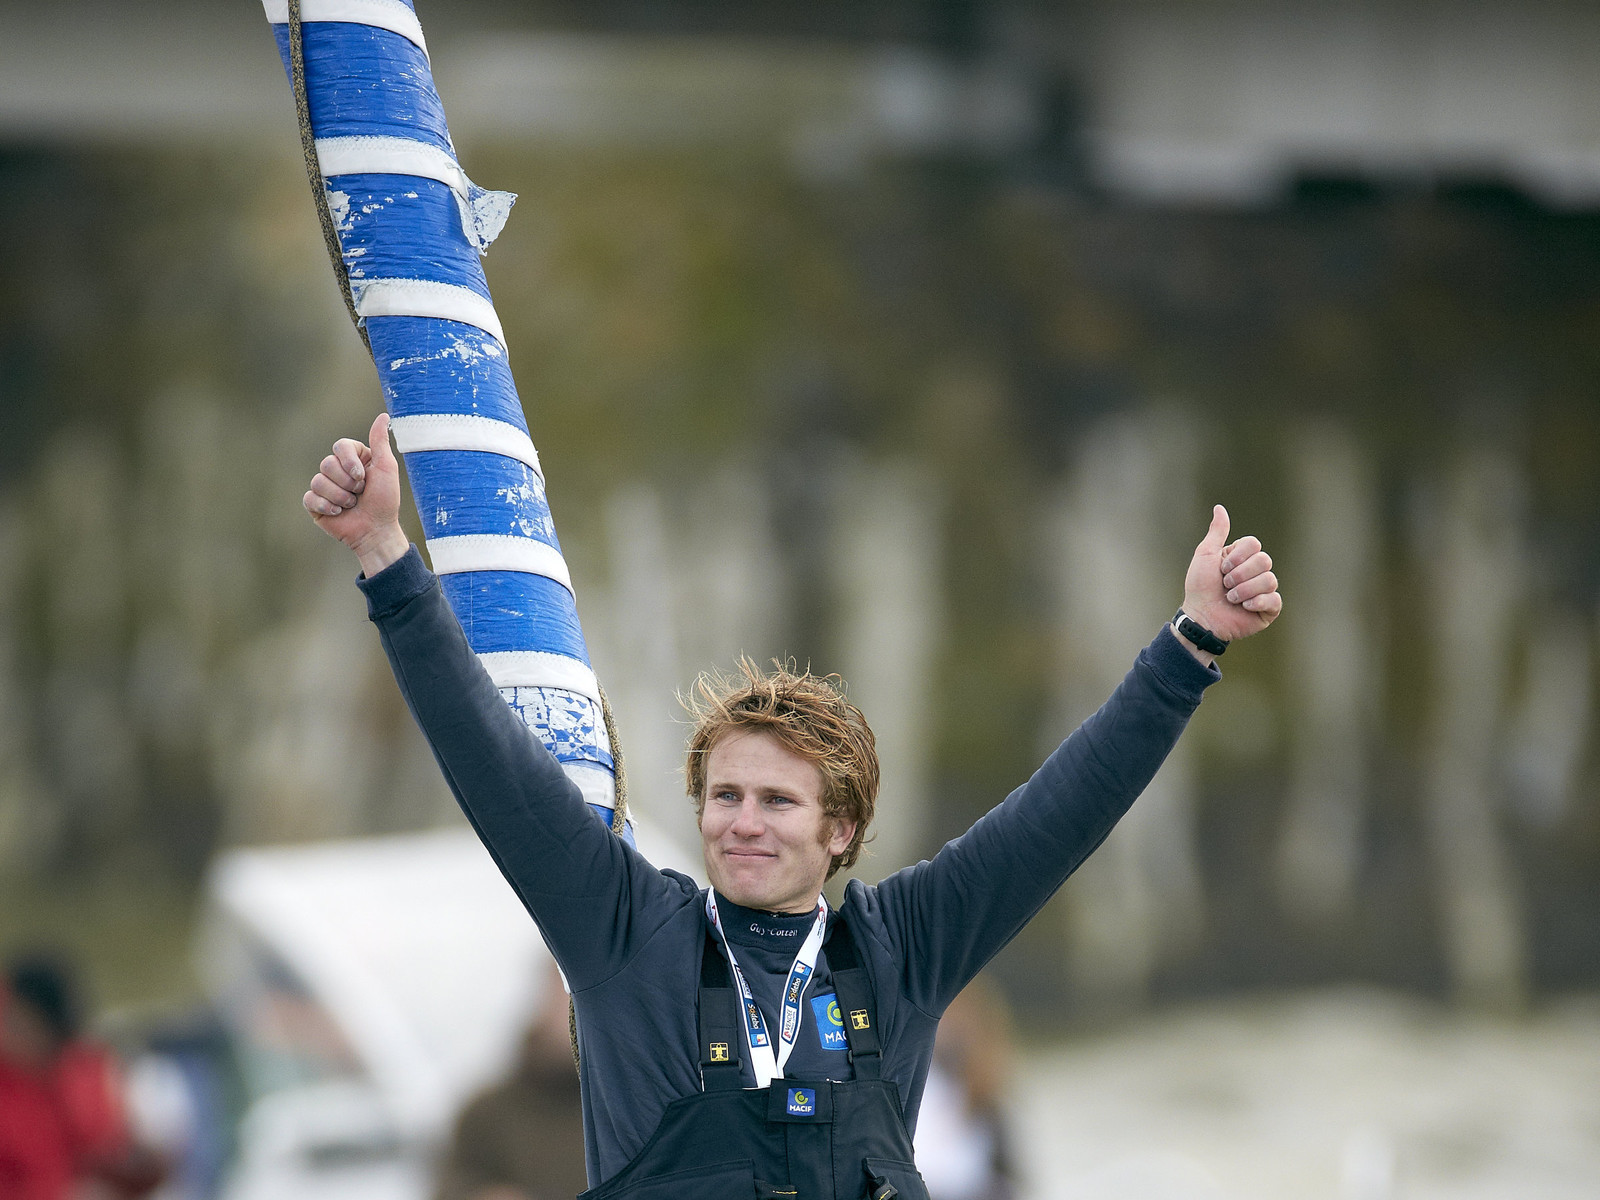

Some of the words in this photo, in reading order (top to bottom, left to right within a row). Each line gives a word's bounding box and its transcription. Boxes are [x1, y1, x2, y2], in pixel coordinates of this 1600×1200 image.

[750, 923, 765, 936] Guy
[824, 1030, 847, 1044] MAC
[789, 1105, 813, 1113] MACIF
